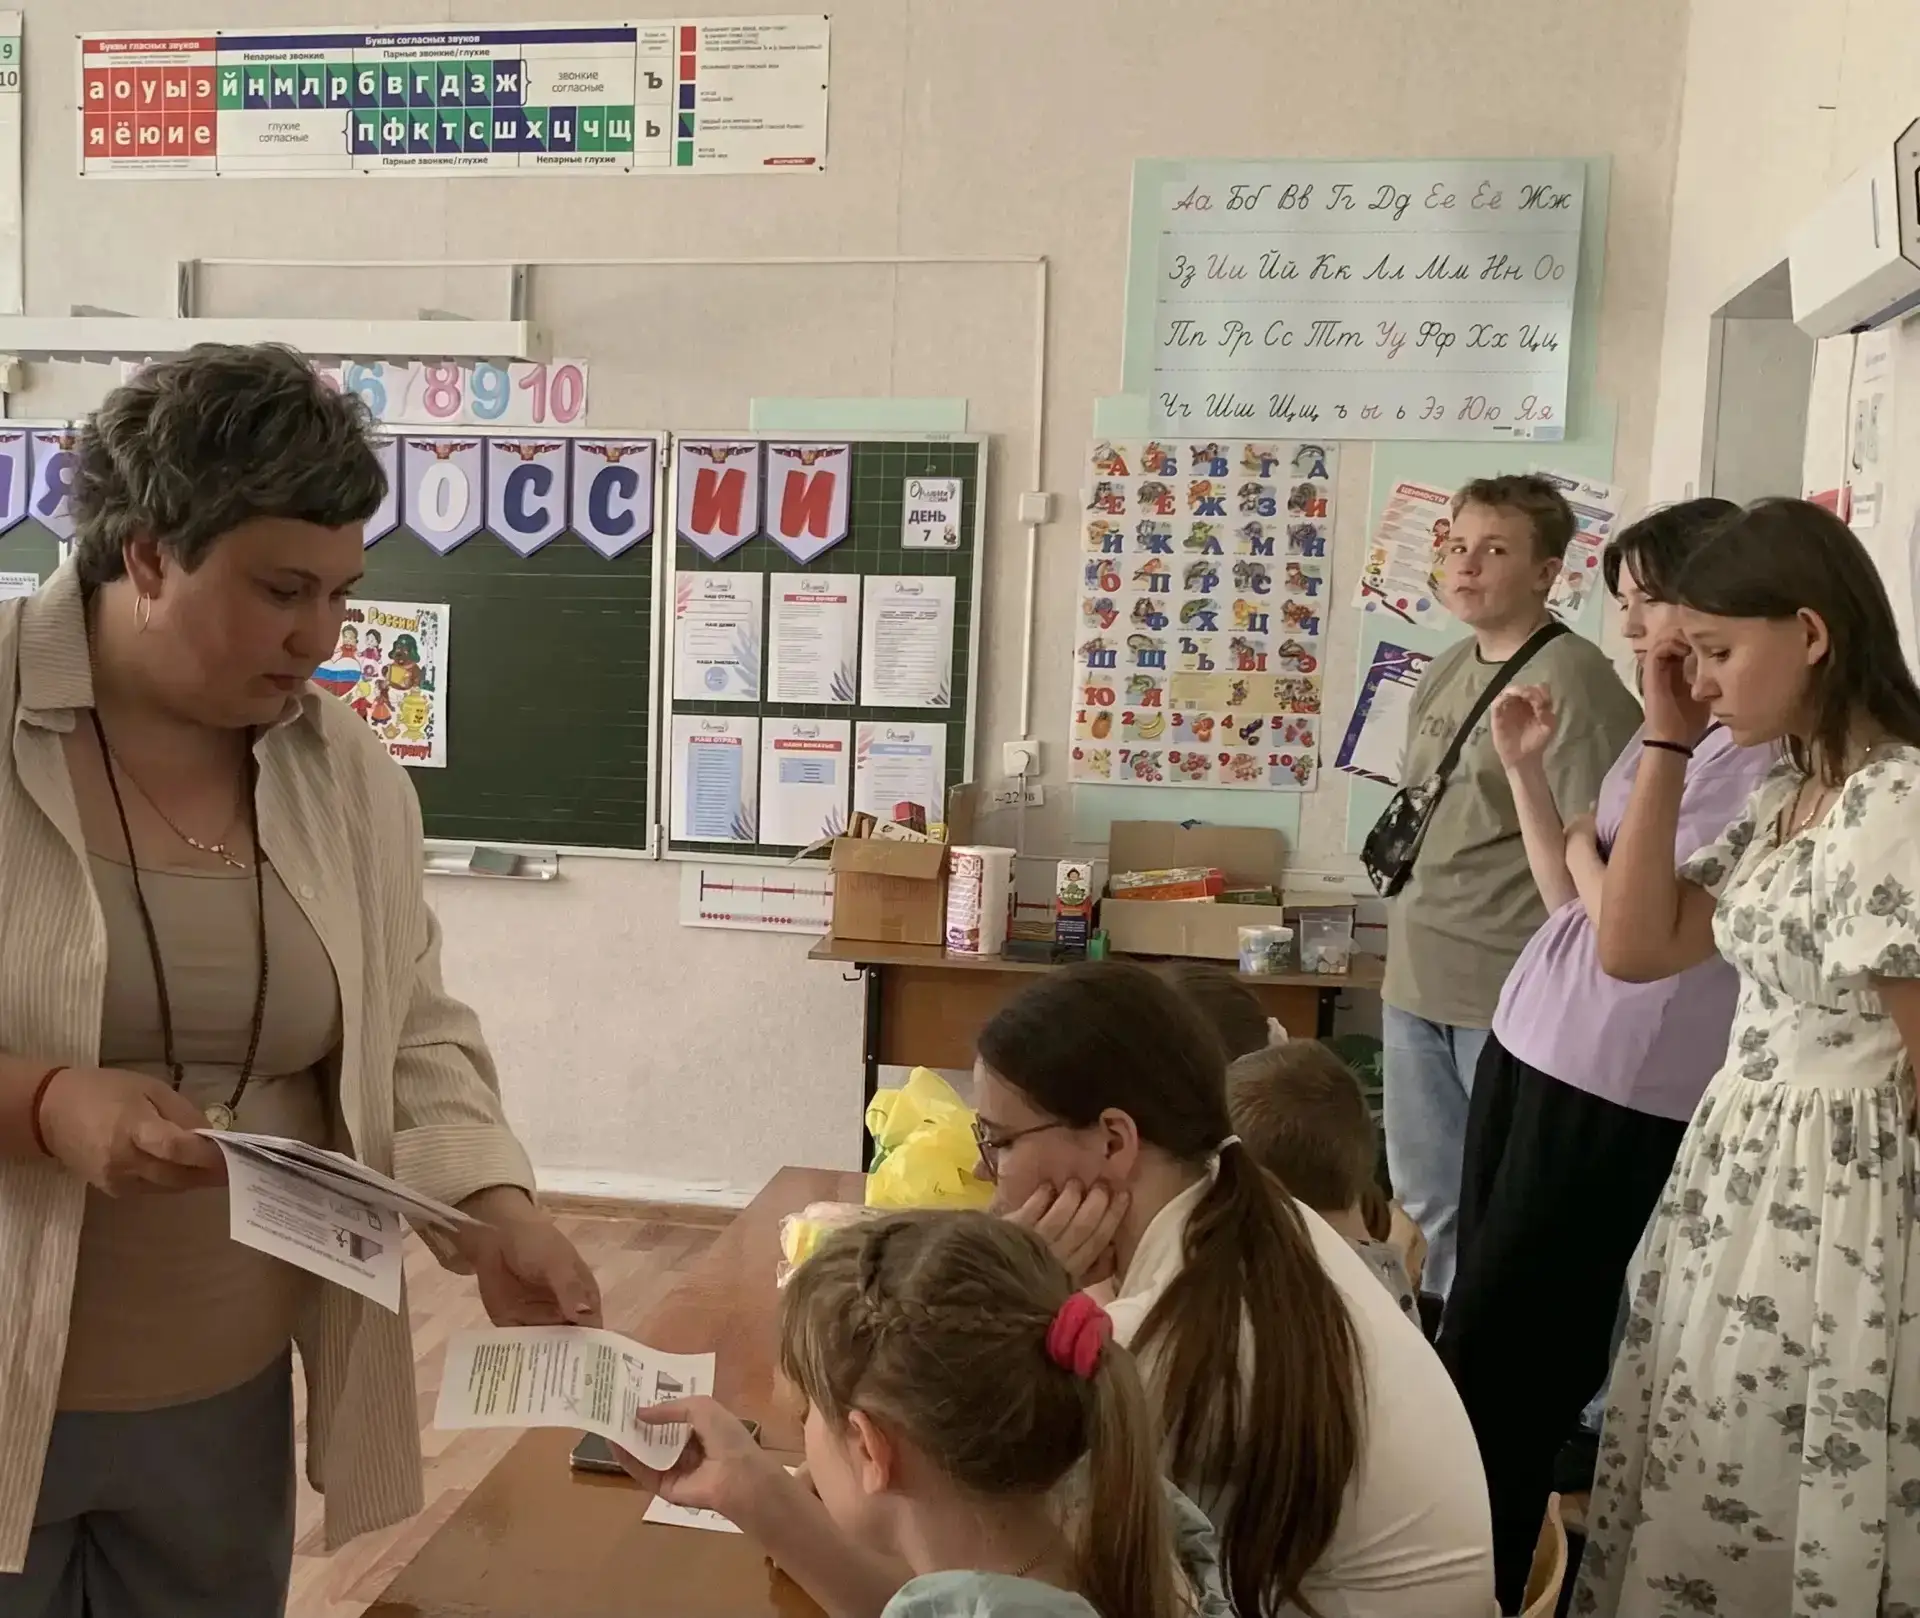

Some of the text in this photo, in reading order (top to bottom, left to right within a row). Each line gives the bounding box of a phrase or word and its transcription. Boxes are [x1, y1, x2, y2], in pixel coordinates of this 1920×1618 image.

[100, 42, 200, 52] Буквы гласных звуков
[365, 36, 480, 47] Буквы согласных звуков
[3, 44, 13, 59] 9
[243, 52, 325, 61] Непарные звонкие
[383, 48, 490, 59] Парные звонкие/глухие
[558, 72, 598, 80] звонкие
[552, 84, 604, 92] согласные
[268, 123, 300, 132] глухие
[259, 134, 309, 143] согласные
[382, 156, 488, 166] Парные звонкие/глухие
[536, 156, 616, 166] Непарные глухие
[1172, 184, 1213, 211] Аа
[1226, 184, 1272, 210] Бб
[1277, 184, 1314, 210] Вв
[1326, 184, 1356, 210] Гг
[1368, 185, 1412, 221] Дд
[1424, 182, 1456, 209] Ее
[1518, 185, 1572, 210] Жж
[1169, 249, 1565, 288] Зз Ии Йй Кк Лл Мм Нн Оо
[1164, 320, 1559, 359] Пп Рр Сс Тт Уу Фф Хх Цц
[422, 361, 461, 418] 8
[471, 362, 510, 420] 9
[518, 363, 584, 424] 10
[1160, 392, 1192, 417] Чч
[1206, 393, 1255, 418] Шш
[1269, 394, 1319, 422] Щщ
[1419, 396, 1445, 420] Ээ
[1457, 396, 1501, 420] Юю
[1514, 395, 1554, 421] Яя
[1108, 454, 1130, 476] А
[1158, 458, 1178, 476] Б
[1208, 457, 1228, 477] В
[1260, 458, 1280, 478] Г
[1107, 496, 1125, 515] Е
[1193, 496, 1227, 516] Ж
[1256, 498, 1276, 516] З
[1304, 498, 1328, 517] И
[908, 510, 946, 524] ДЕНЬ
[923, 530, 931, 542] 7
[1102, 528, 1326, 557] Й К Л М Н
[1100, 573, 1322, 596] О П Р С Т
[1098, 610, 1320, 636] У Ф Х Ц Ч
[1087, 650, 1117, 668] Ш
[1137, 650, 1166, 670] Щ
[1237, 652, 1268, 672] Ы
[1298, 654, 1317, 673] Э
[1085, 687, 1163, 707] Ю Я
[1076, 710, 1284, 729] 1 2 3 4 5
[1073, 747, 1292, 766] 6 7 8 9 10
